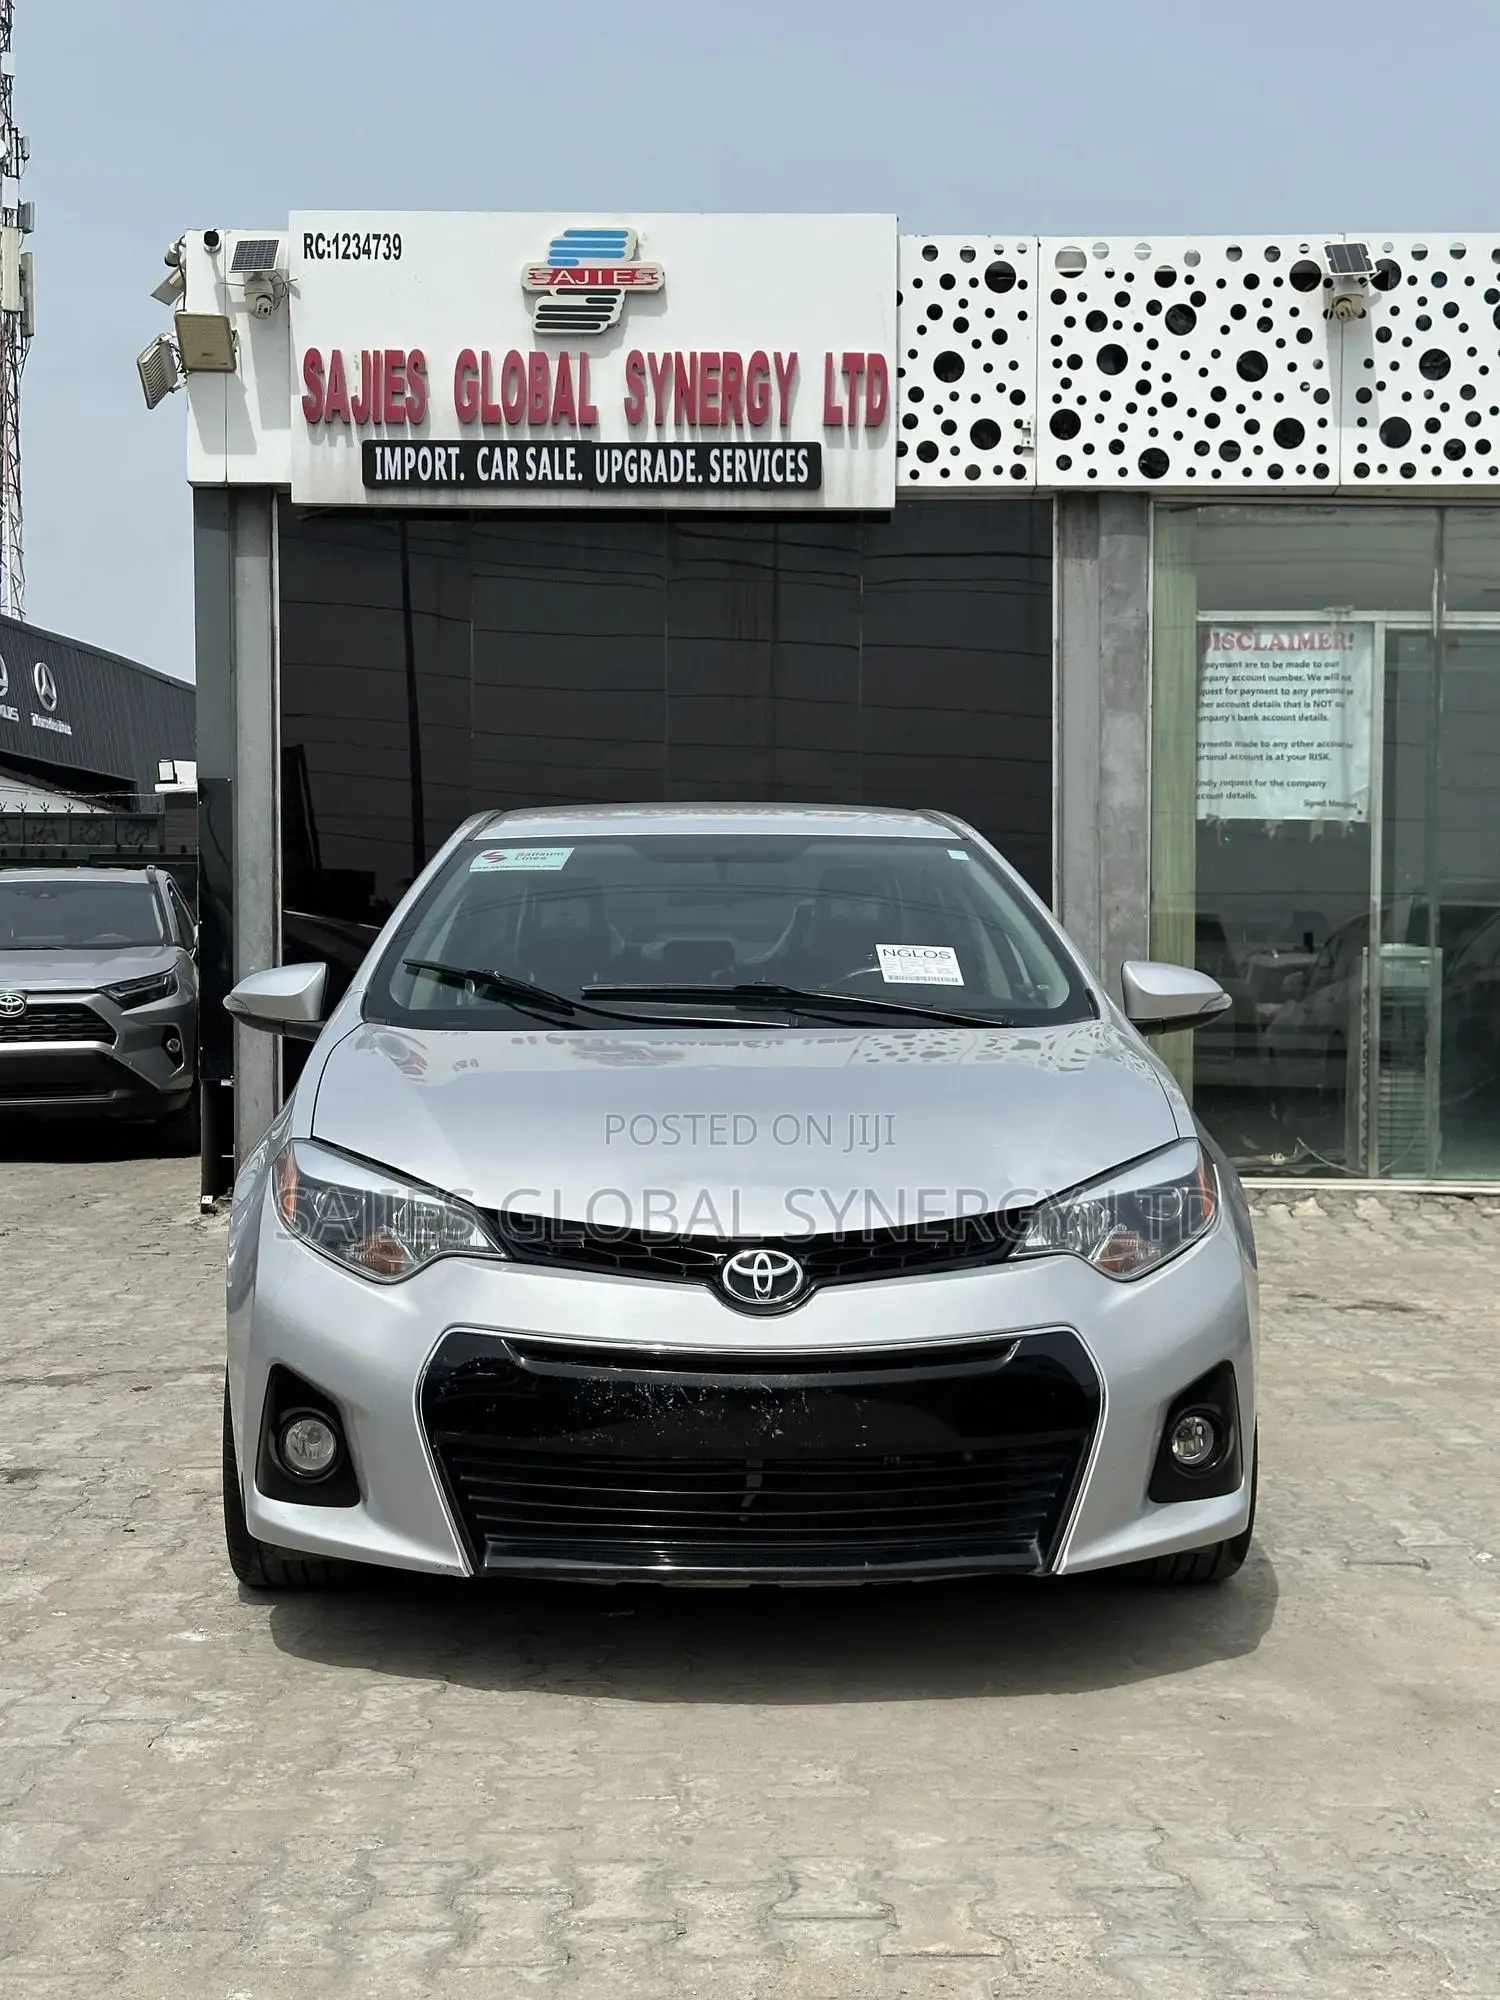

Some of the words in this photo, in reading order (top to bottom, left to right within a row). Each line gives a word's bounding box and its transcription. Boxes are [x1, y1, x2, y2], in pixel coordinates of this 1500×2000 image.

[303, 232, 402, 260] RC:1234739
[528, 268, 660, 285] SAJIES
[302, 347, 428, 425] SAJIES
[454, 348, 598, 425] GLOBAL
[624, 349, 798, 427] SYNERGY
[823, 352, 889, 427] LTD
[375, 446, 465, 481] IMPORT.
[477, 446, 519, 481] CAR
[525, 447, 583, 481] SALE.
[595, 448, 703, 483] UPGRADE.
[709, 448, 809, 483] SERVICES
[1260, 661, 1270, 669] to
[1272, 660, 1283, 669] be
[1286, 660, 1310, 669] made
[1313, 661, 1322, 669] to
[1231, 674, 1266, 682] account
[1307, 674, 1321, 682] We
[1225, 687, 1237, 696] for
[1240, 687, 1278, 698] payment
[1280, 687, 1290, 696] to
[1292, 688, 1308, 698] any
[1216, 700, 1250, 709] account
[1252, 700, 1281, 708] details
[1283, 700, 1300, 709] that
[1303, 700, 1310, 709] is
[1313, 700, 1332, 708] NOT
[1238, 713, 1259, 722] bank
[1261, 713, 1296, 722] account
[1234, 740, 1258, 748] made
[1260, 740, 1270, 748] to
[1272, 741, 1288, 750] any
[1290, 740, 1314, 748] other
[1229, 752, 1263, 761] account
[1265, 752, 1273, 761] is
[1275, 753, 1284, 761] at
[1286, 753, 1306, 762] your
[1219, 779, 1252, 789] request
[1255, 779, 1267, 787] for
[1270, 779, 1284, 787] the
[1286, 780, 1327, 789] company
[883, 949, 951, 959] NGLOS
